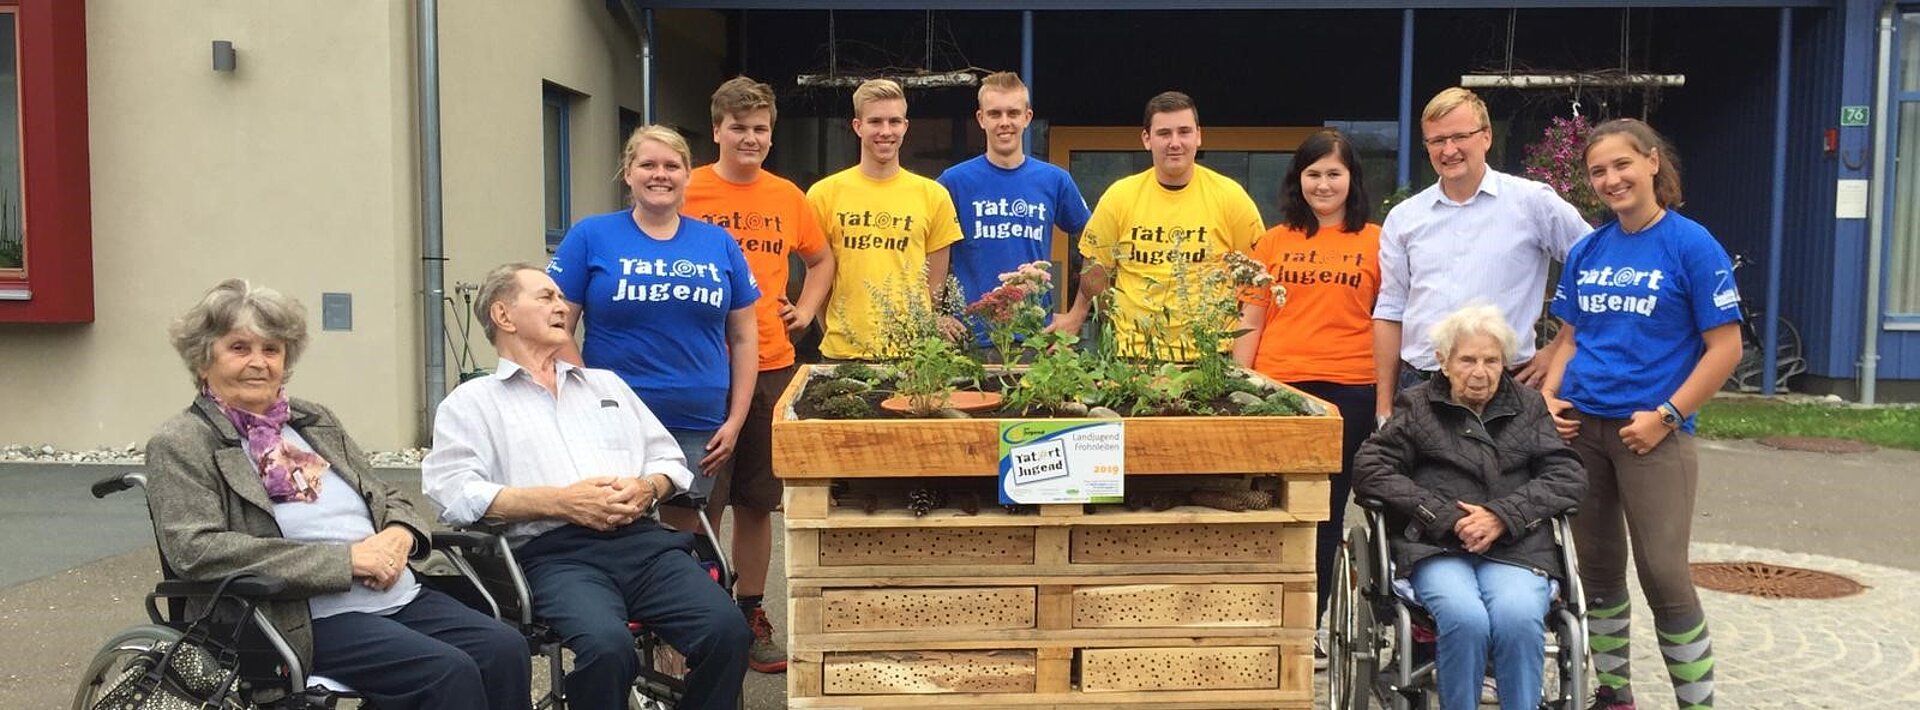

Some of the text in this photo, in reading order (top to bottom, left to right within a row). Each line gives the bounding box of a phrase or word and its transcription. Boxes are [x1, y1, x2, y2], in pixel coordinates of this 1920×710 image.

[1847, 109, 1864, 121] 76
[973, 220, 1044, 242] Jugend
[612, 278, 723, 309] Jugend
[1577, 289, 1658, 317] ugend
[1072, 433, 1120, 442] Landjugend
[1075, 442, 1120, 451] Frohnleiten
[1018, 460, 1064, 477] Jugend
[1094, 465, 1120, 475] 2019
